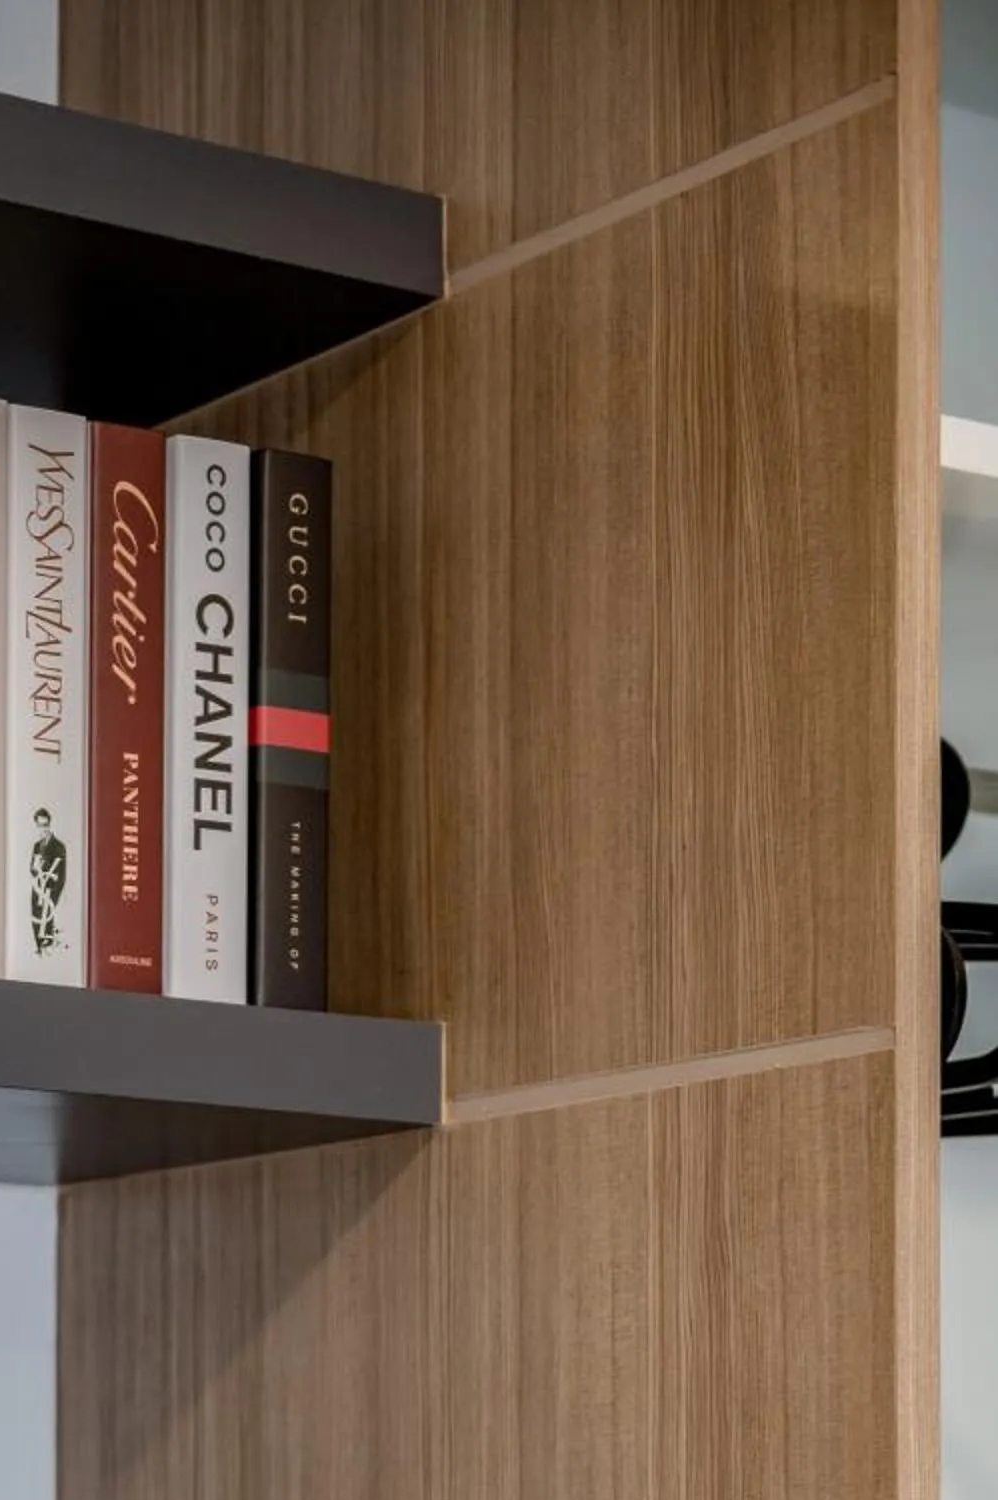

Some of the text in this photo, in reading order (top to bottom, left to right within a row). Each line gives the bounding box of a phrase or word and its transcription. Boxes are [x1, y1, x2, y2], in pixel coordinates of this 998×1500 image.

[112, 480, 159, 704] Cartier
[287, 493, 309, 624] GUCCI
[194, 464, 235, 851] COCO CHANEL
[121, 752, 140, 901] PANTHERE
[289, 821, 301, 970] THE MAKING OF
[205, 894, 219, 971] PARIS
